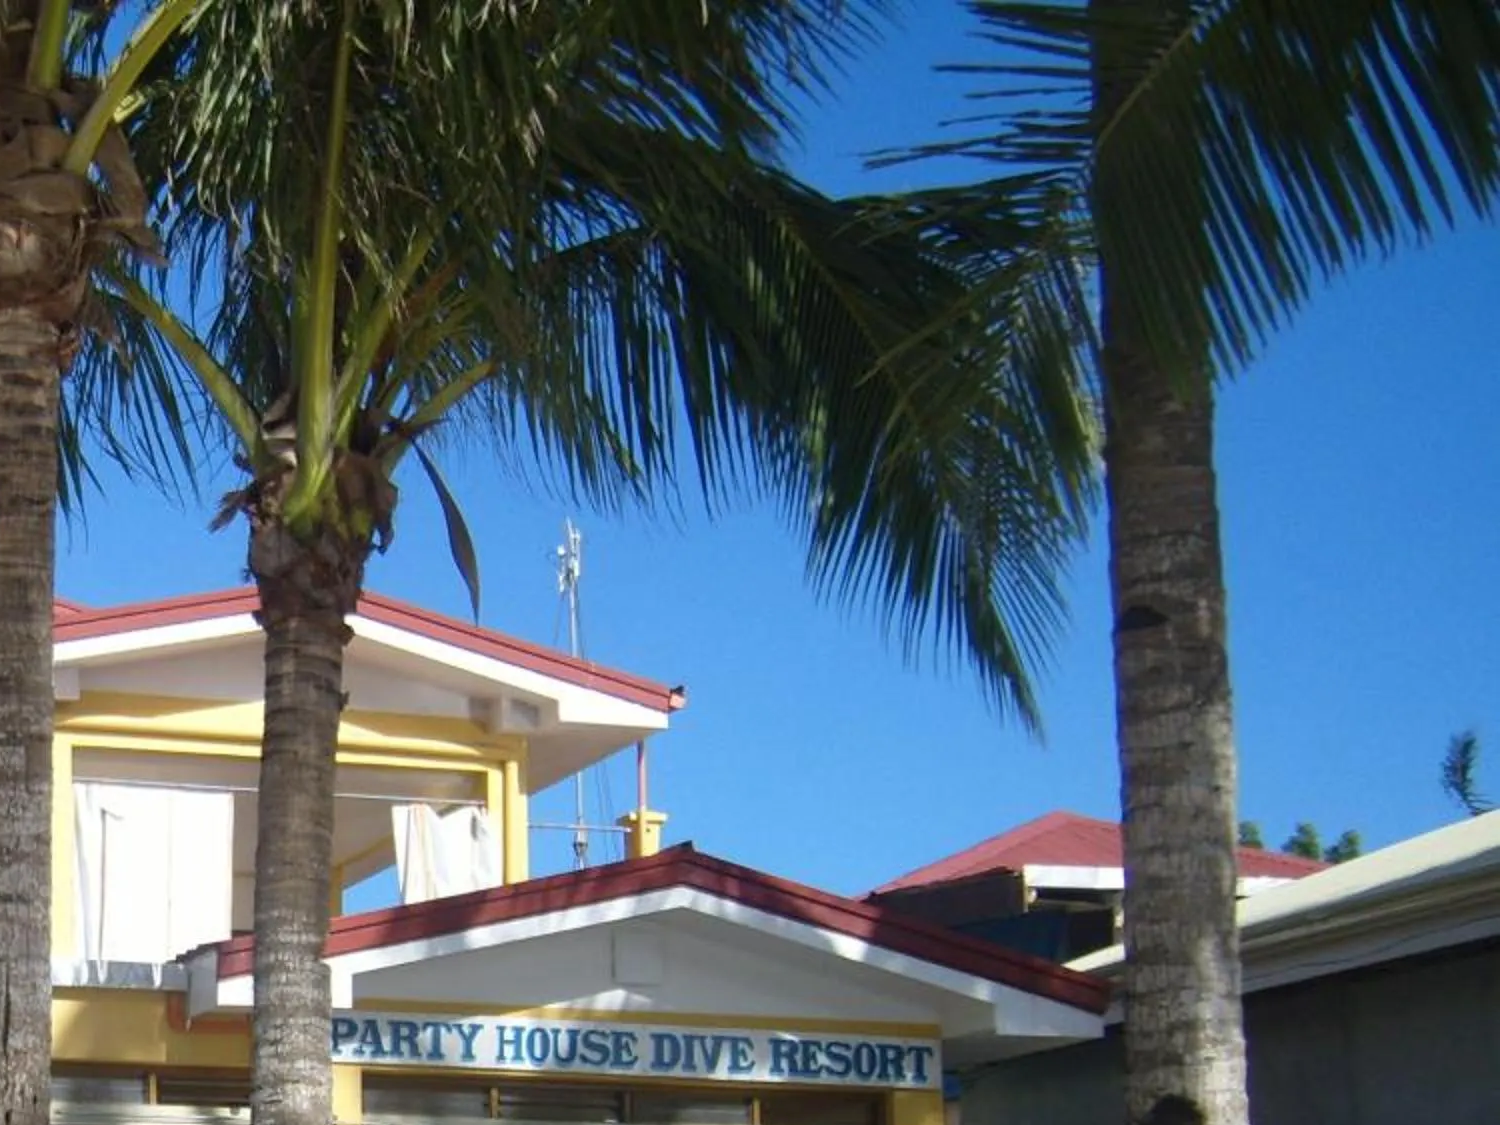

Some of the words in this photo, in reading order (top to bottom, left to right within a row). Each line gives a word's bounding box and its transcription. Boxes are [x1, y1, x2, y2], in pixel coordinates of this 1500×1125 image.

[331, 1017, 484, 1062] PARTY
[495, 1024, 639, 1071] HOUSE
[649, 1032, 756, 1076] DIVE
[768, 1037, 934, 1084] RESORT
